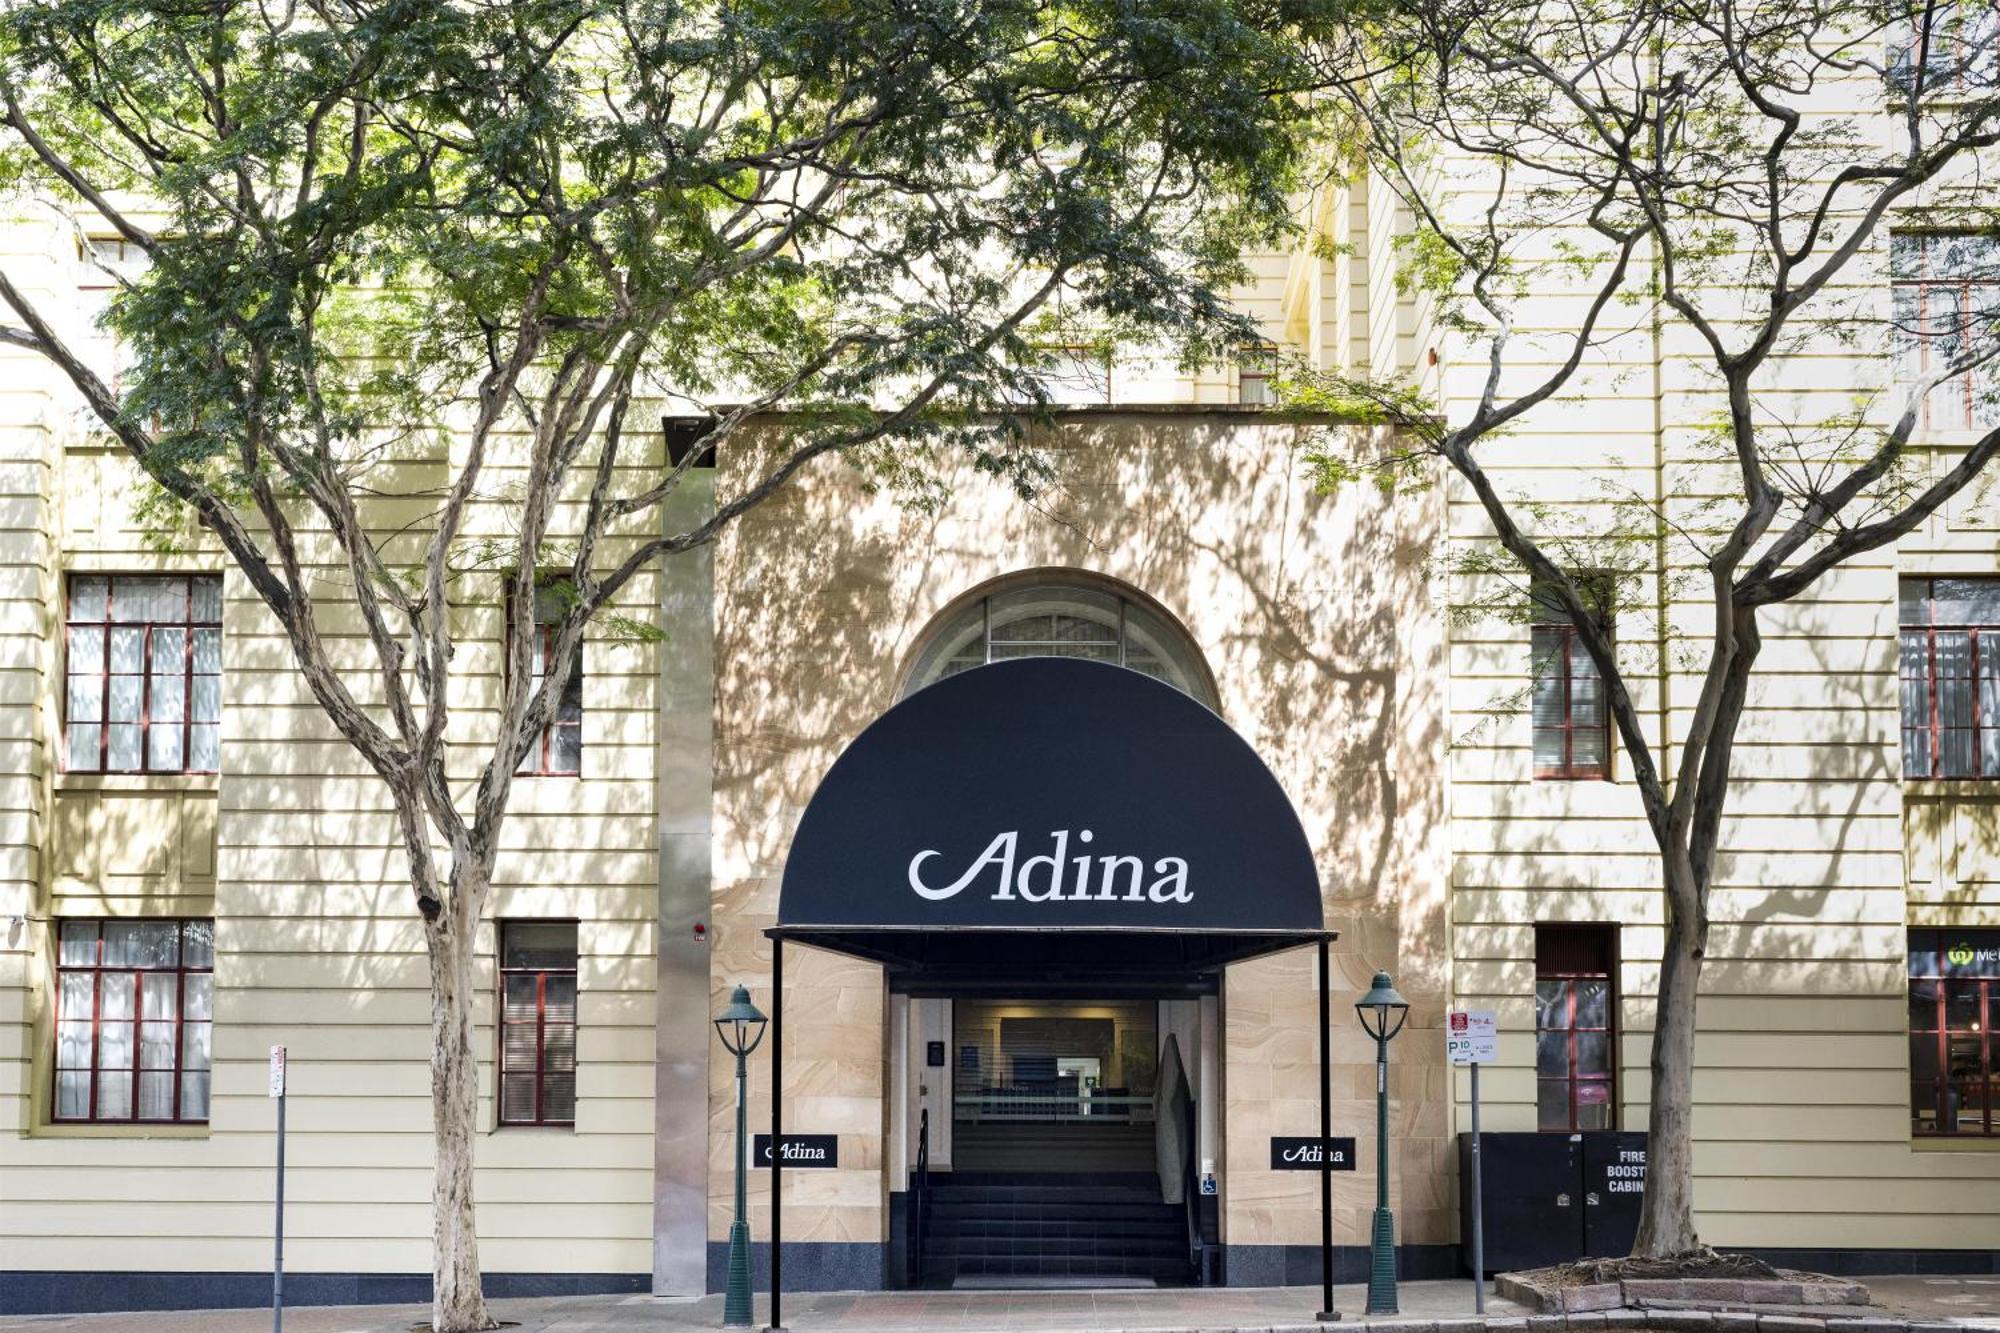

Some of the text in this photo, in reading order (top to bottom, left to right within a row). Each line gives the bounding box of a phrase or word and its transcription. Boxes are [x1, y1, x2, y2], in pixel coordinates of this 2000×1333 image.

[908, 829, 1194, 904] Adina
[1448, 1041, 1458, 1054] P
[1460, 1040, 1470, 1049] 10
[1619, 1151, 1646, 1163] FIRE
[1607, 1165, 1648, 1178] BOOST
